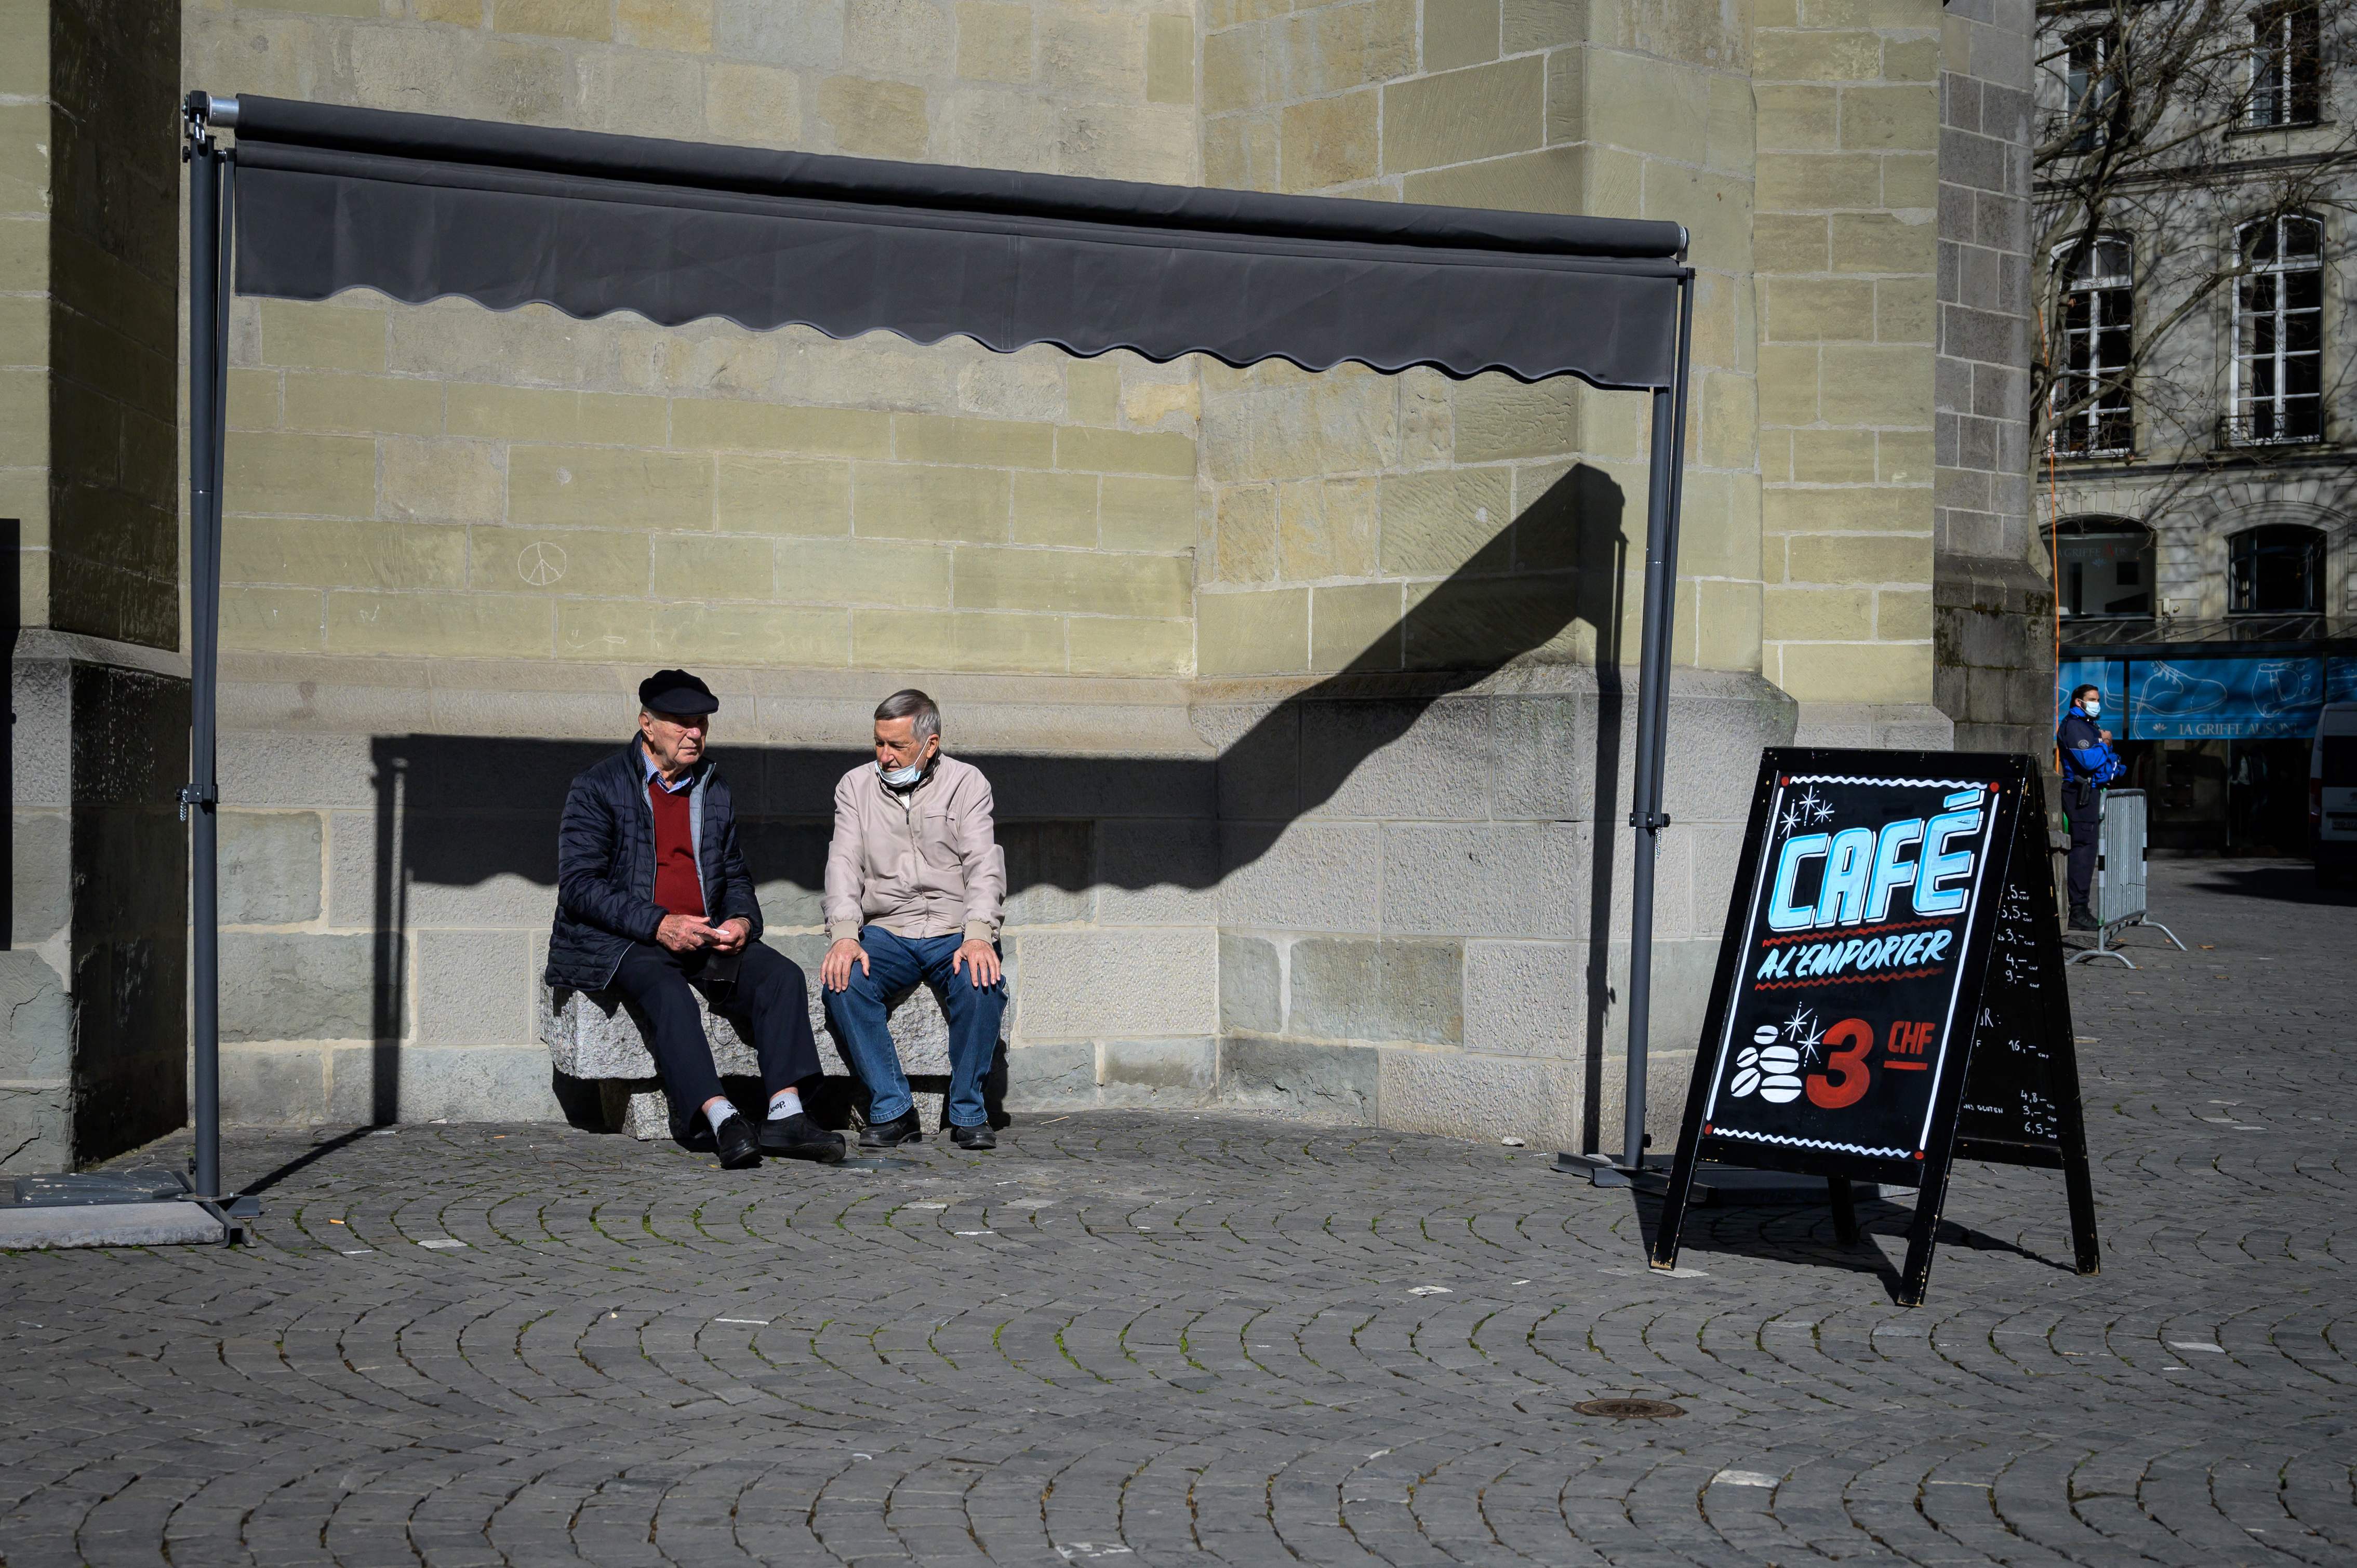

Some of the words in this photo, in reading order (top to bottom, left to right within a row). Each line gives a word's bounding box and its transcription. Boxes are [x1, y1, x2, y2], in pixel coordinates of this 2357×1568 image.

[2195, 723, 2243, 735] GRIFFE
[1768, 789, 1985, 932] CAFÉ
[1806, 1018, 1874, 1109] 3
[1887, 1021, 1936, 1055] CHF
[1977, 1104, 2004, 1114] GLUTEN
